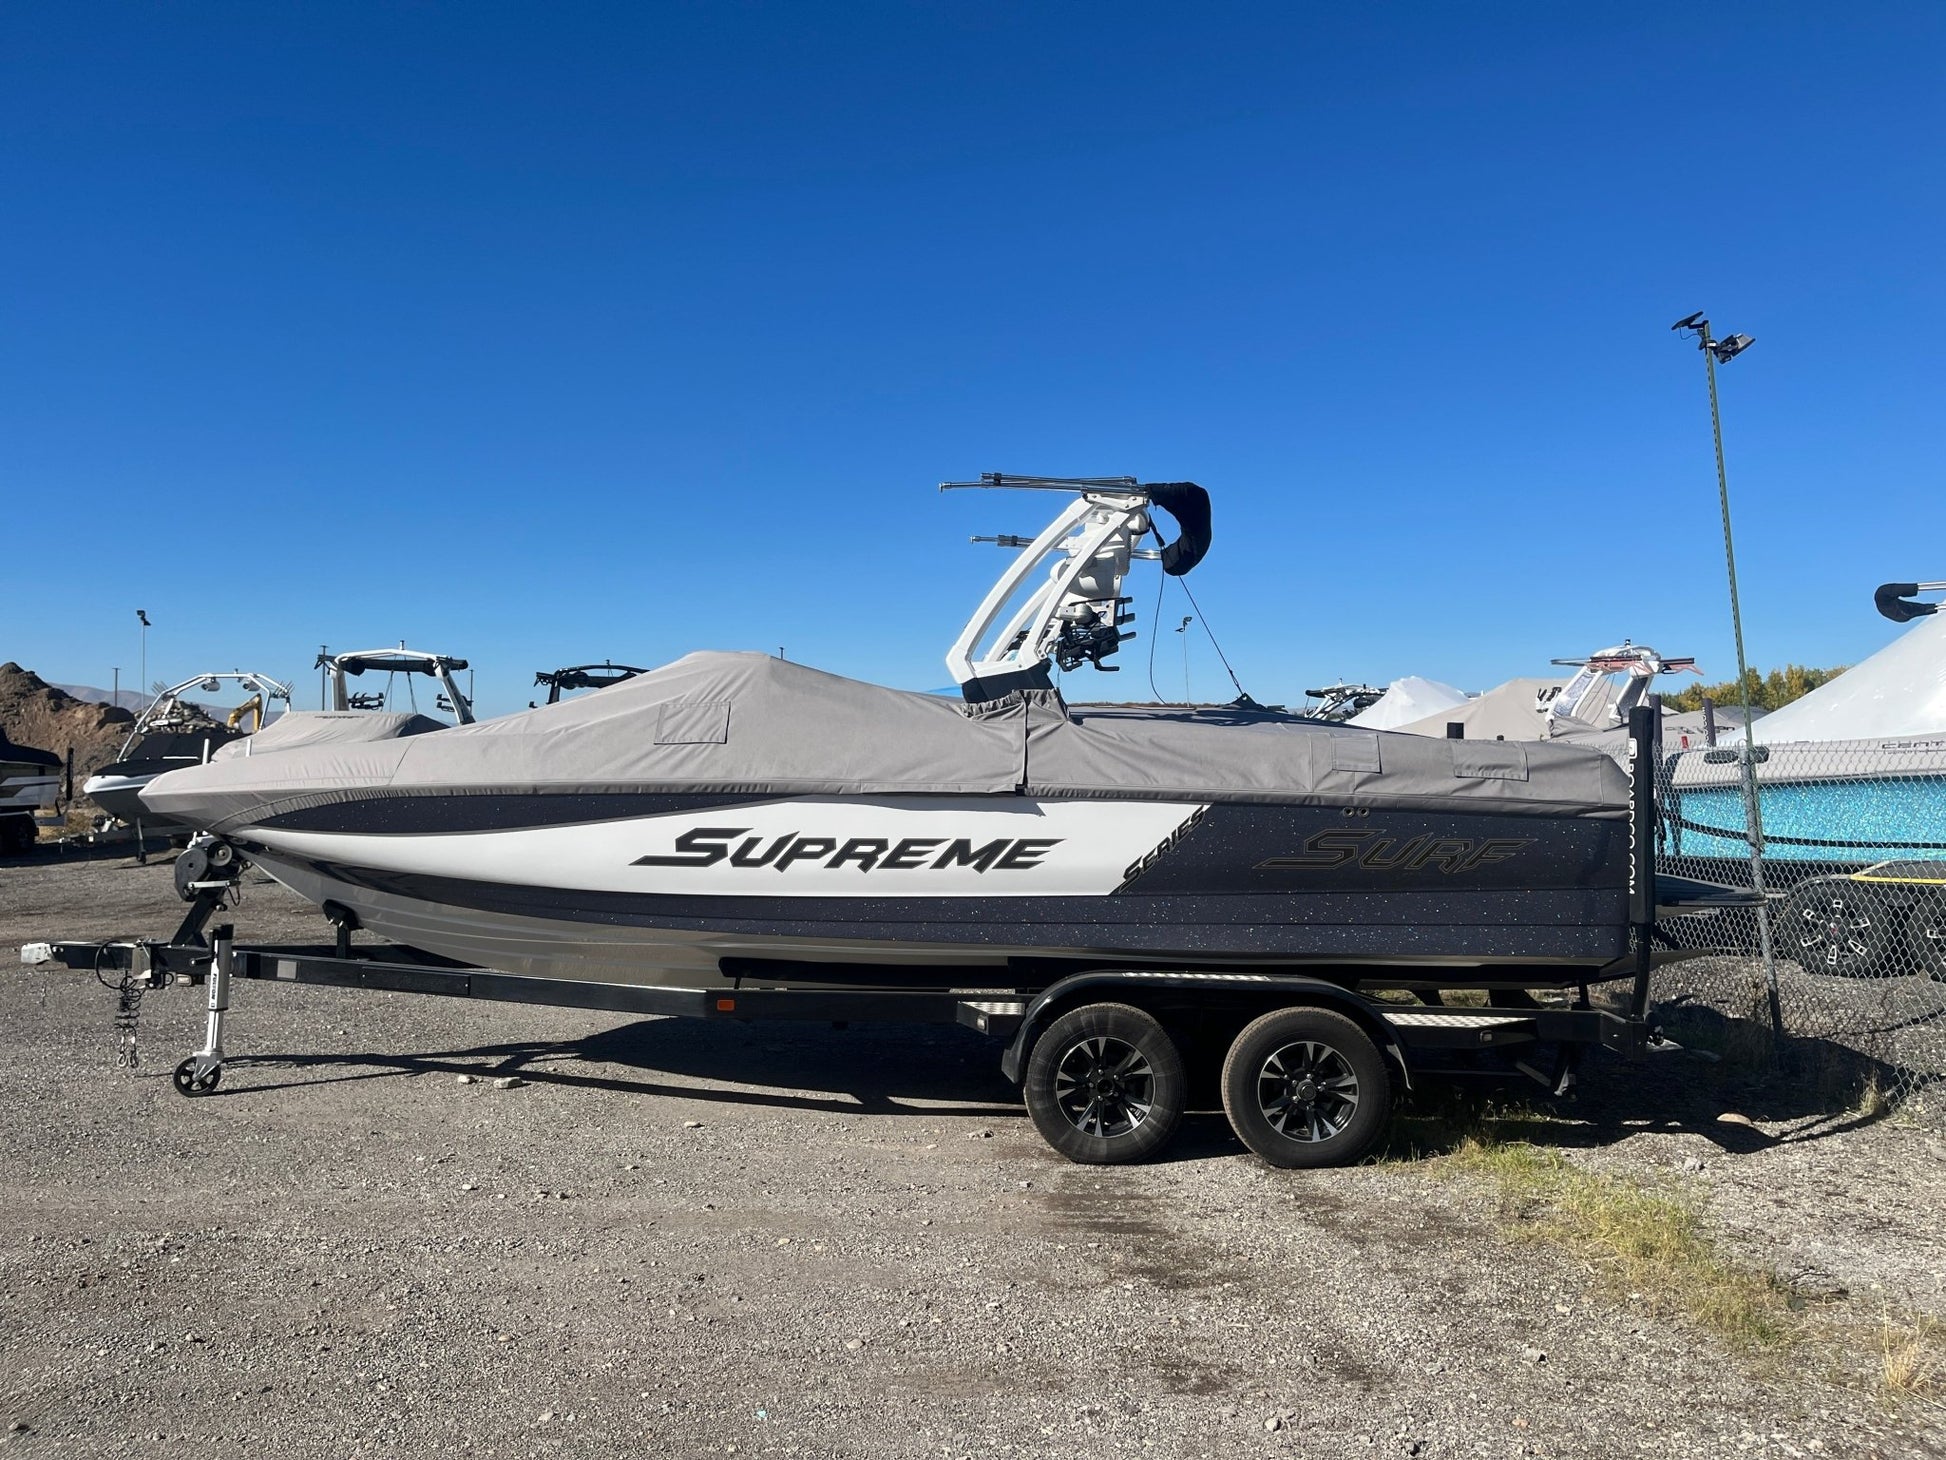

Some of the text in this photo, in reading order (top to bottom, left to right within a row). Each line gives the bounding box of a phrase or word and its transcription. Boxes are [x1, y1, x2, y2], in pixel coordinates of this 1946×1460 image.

[628, 826, 1066, 874] SUPREME
[1114, 804, 1206, 894] SERIES
[1252, 827, 1539, 873] SURF
